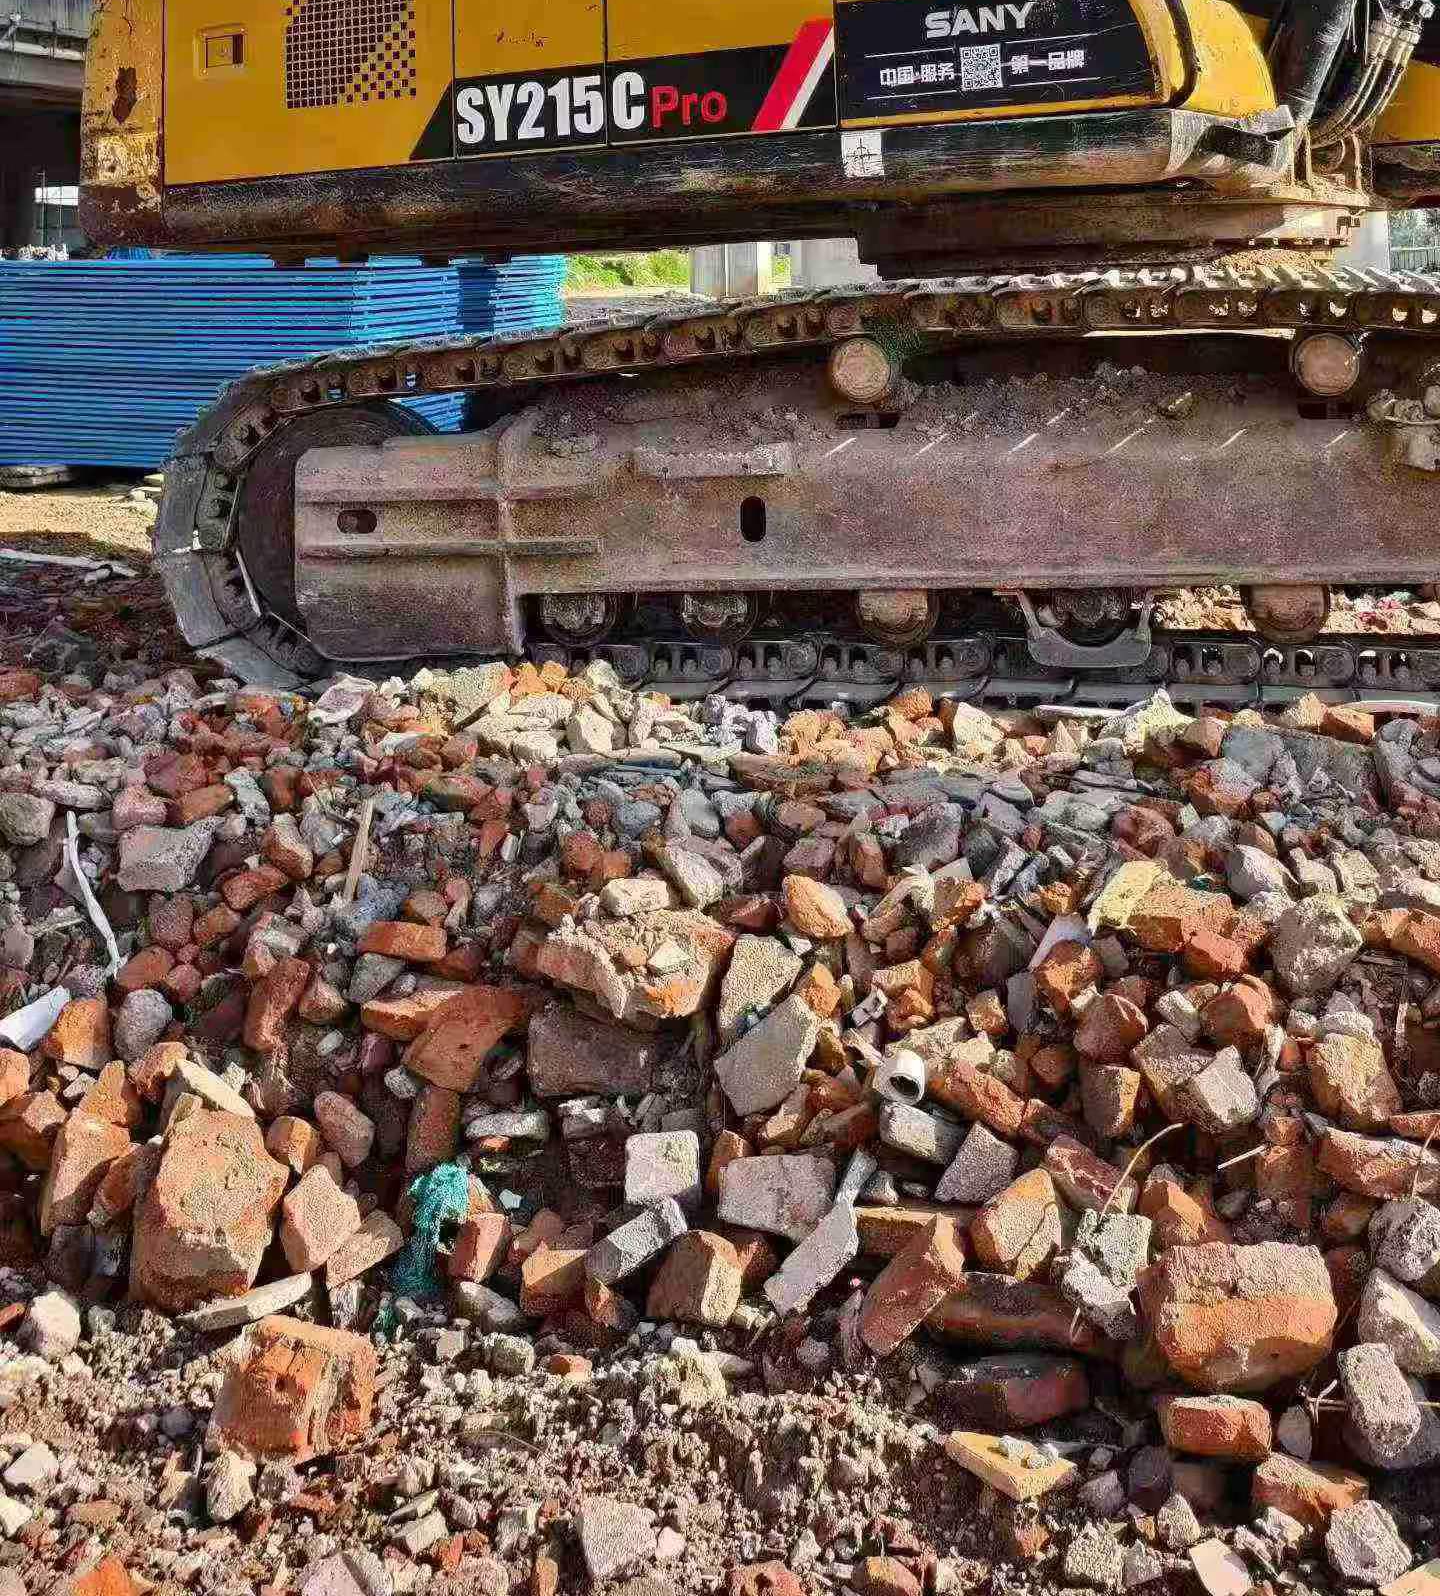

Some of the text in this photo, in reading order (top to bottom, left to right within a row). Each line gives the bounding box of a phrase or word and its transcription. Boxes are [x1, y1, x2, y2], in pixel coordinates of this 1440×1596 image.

[925, 1, 1036, 38] SANY
[457, 72, 728, 145] SY215C Pro
